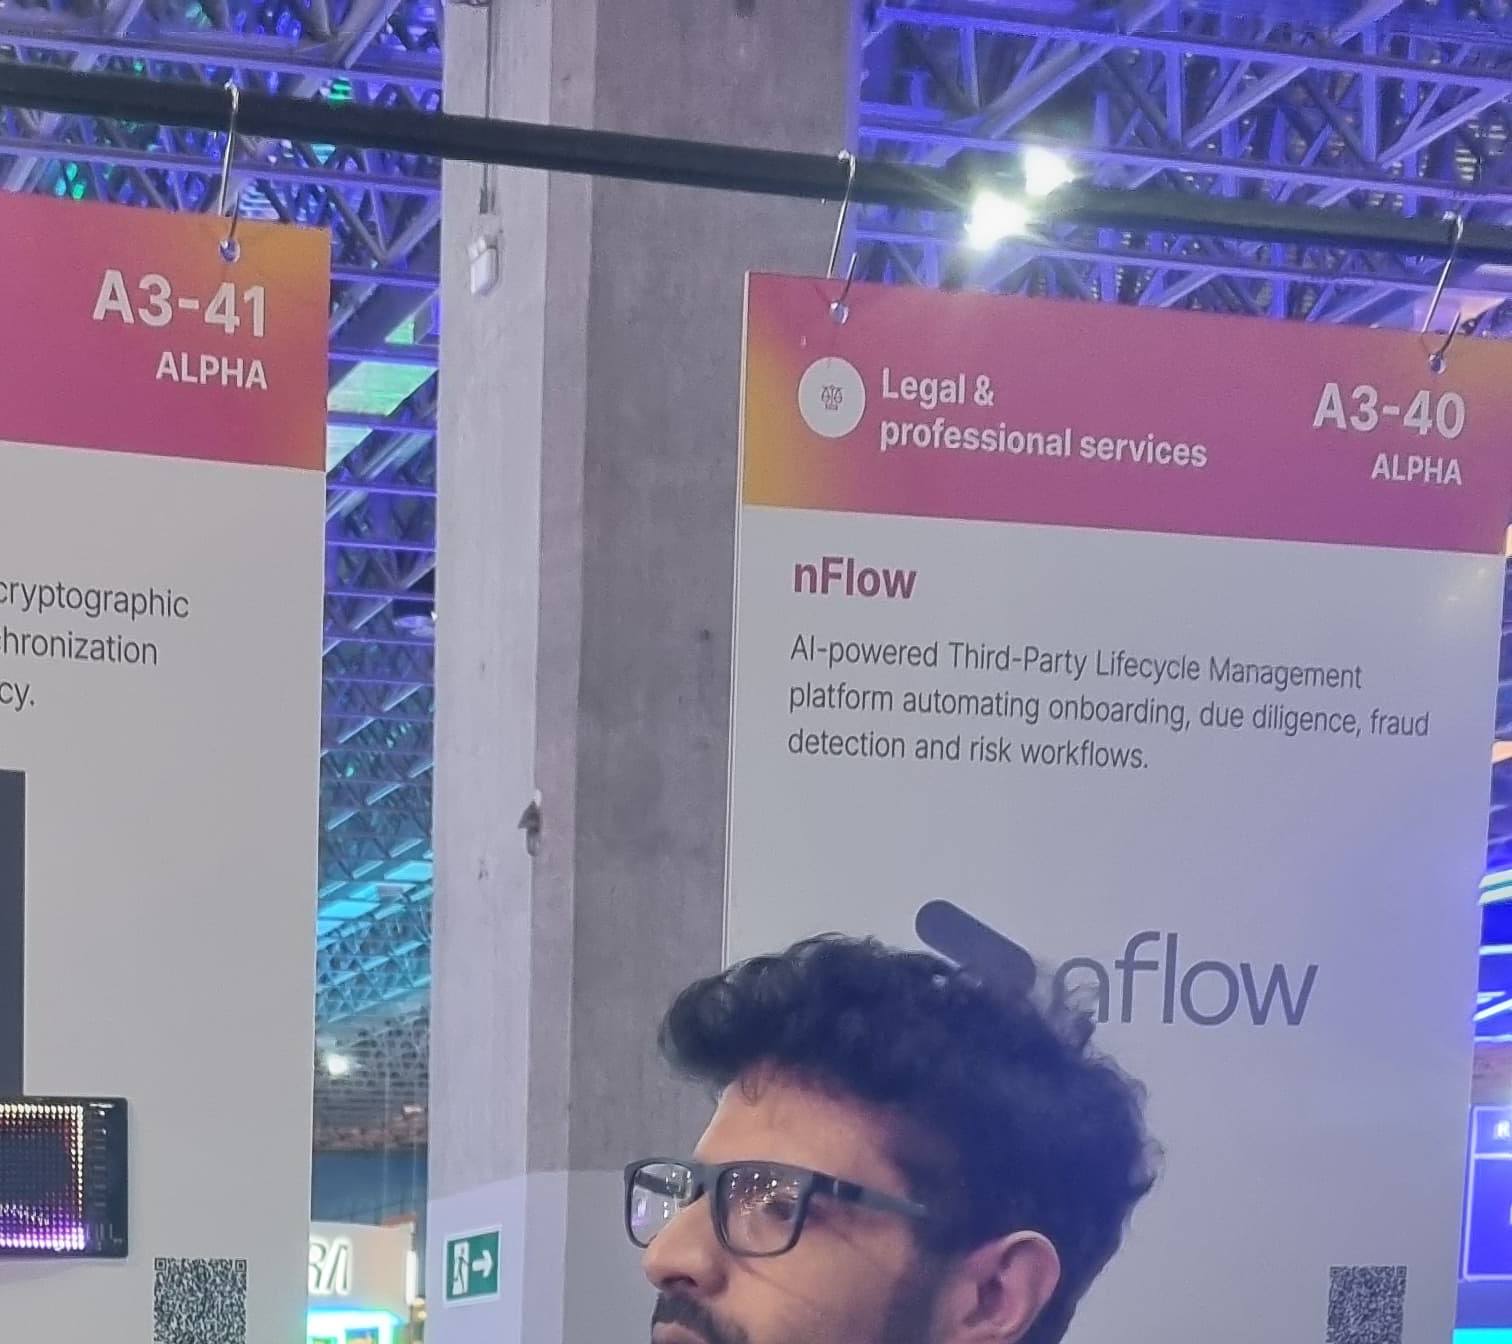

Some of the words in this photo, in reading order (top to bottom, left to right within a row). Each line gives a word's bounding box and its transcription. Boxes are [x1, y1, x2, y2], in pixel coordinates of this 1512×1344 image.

[92, 269, 266, 338] A3-41
[155, 350, 268, 390] ALPHA
[882, 367, 966, 410] Legal
[973, 374, 995, 407] &
[1312, 382, 1466, 440] A3-40
[879, 416, 1072, 457] professional
[1079, 433, 1208, 468] services
[1370, 453, 1462, 486] ALPHA
[793, 556, 917, 599] nFlow
[790, 634, 938, 670] AI-powered
[948, 641, 1088, 681] Third-Party
[1096, 649, 1201, 686] Lifecycle
[1209, 655, 1362, 692] Management
[789, 681, 893, 714] platform
[903, 689, 1039, 725] automating
[1048, 694, 1191, 733] onboarding,
[1199, 701, 1244, 729] due
[1252, 703, 1362, 738] diligence,
[1370, 707, 1430, 737] fraud
[788, 727, 906, 760] detection
[915, 734, 961, 762] and
[970, 735, 1012, 763] risk
[1021, 738, 1149, 769] workflows.
